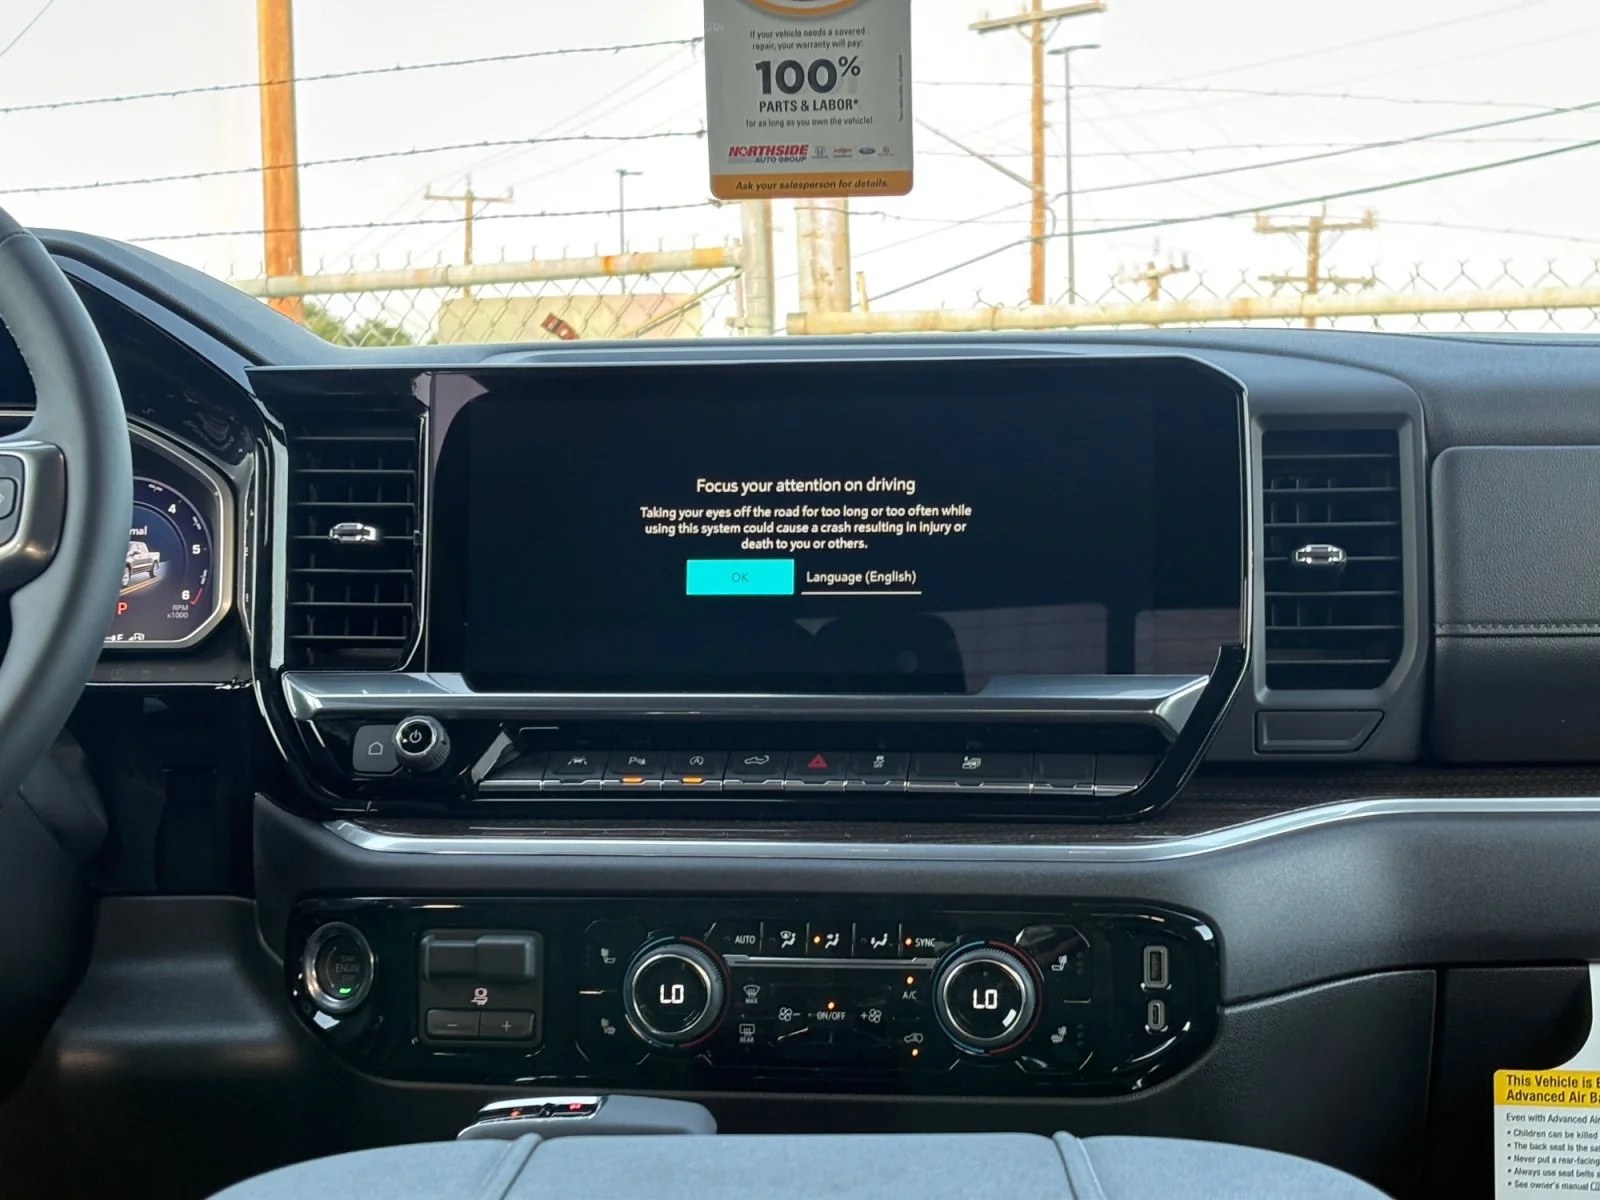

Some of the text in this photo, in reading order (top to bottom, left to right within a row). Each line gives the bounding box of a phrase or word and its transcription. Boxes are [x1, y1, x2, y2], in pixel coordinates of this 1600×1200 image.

[758, 30, 773, 39] your
[775, 28, 802, 37] vehicle
[804, 28, 827, 36] needs
[835, 26, 865, 36] covered
[752, 39, 863, 51] repair, your warranty will pay:
[755, 56, 861, 95] 100%
[759, 100, 798, 113] PARTS
[802, 99, 809, 112] &
[746, 119, 756, 128] for
[768, 118, 784, 128] long
[797, 119, 810, 128] you
[829, 116, 842, 125] the
[844, 114, 873, 125] vehicle!
[728, 144, 808, 157] NORTHSIDE
[736, 178, 888, 191] Ask your salesperson for details.
[697, 476, 915, 496] Focus your attention on driving
[168, 504, 176, 514] 4
[640, 505, 972, 521] Taking your eyes off the road for too long or too often while
[645, 521, 966, 536] using this system could cause a crash resulting in injury or
[192, 545, 201, 554] 5
[741, 538, 868, 552] death to you or others.
[732, 572, 748, 583] OK
[806, 570, 917, 585] Language (English)
[181, 590, 190, 600] 6
[118, 602, 127, 615] P
[734, 936, 756, 944] AUTO
[915, 938, 936, 948] SYNC
[660, 984, 684, 1004] LO
[902, 991, 917, 1000] A/C
[972, 988, 998, 1010] LO
[816, 1011, 846, 1020] ON/OFF
[1507, 1075, 1531, 1086] This
[1535, 1075, 1578, 1088] Vehicle
[1582, 1077, 1592, 1088] is
[1507, 1090, 1565, 1102] Advanced
[1569, 1092, 1586, 1103] Air
[1506, 1113, 1525, 1121] Even
[1528, 1114, 1545, 1122] with
[1548, 1114, 1587, 1124] Advanced
[1514, 1129, 1545, 1138] Children
[1565, 1131, 1574, 1139] be
[1577, 1131, 1598, 1139] killed
[1514, 1142, 1527, 1150] The
[1576, 1144, 1588, 1152] the
[1514, 1154, 1535, 1163] Never
[1538, 1155, 1550, 1164] put
[1559, 1156, 1600, 1167] rear-facing
[1514, 1168, 1541, 1177] Always
[1576, 1170, 1594, 1178] belts
[1515, 1180, 1588, 1190] See owner's manual
